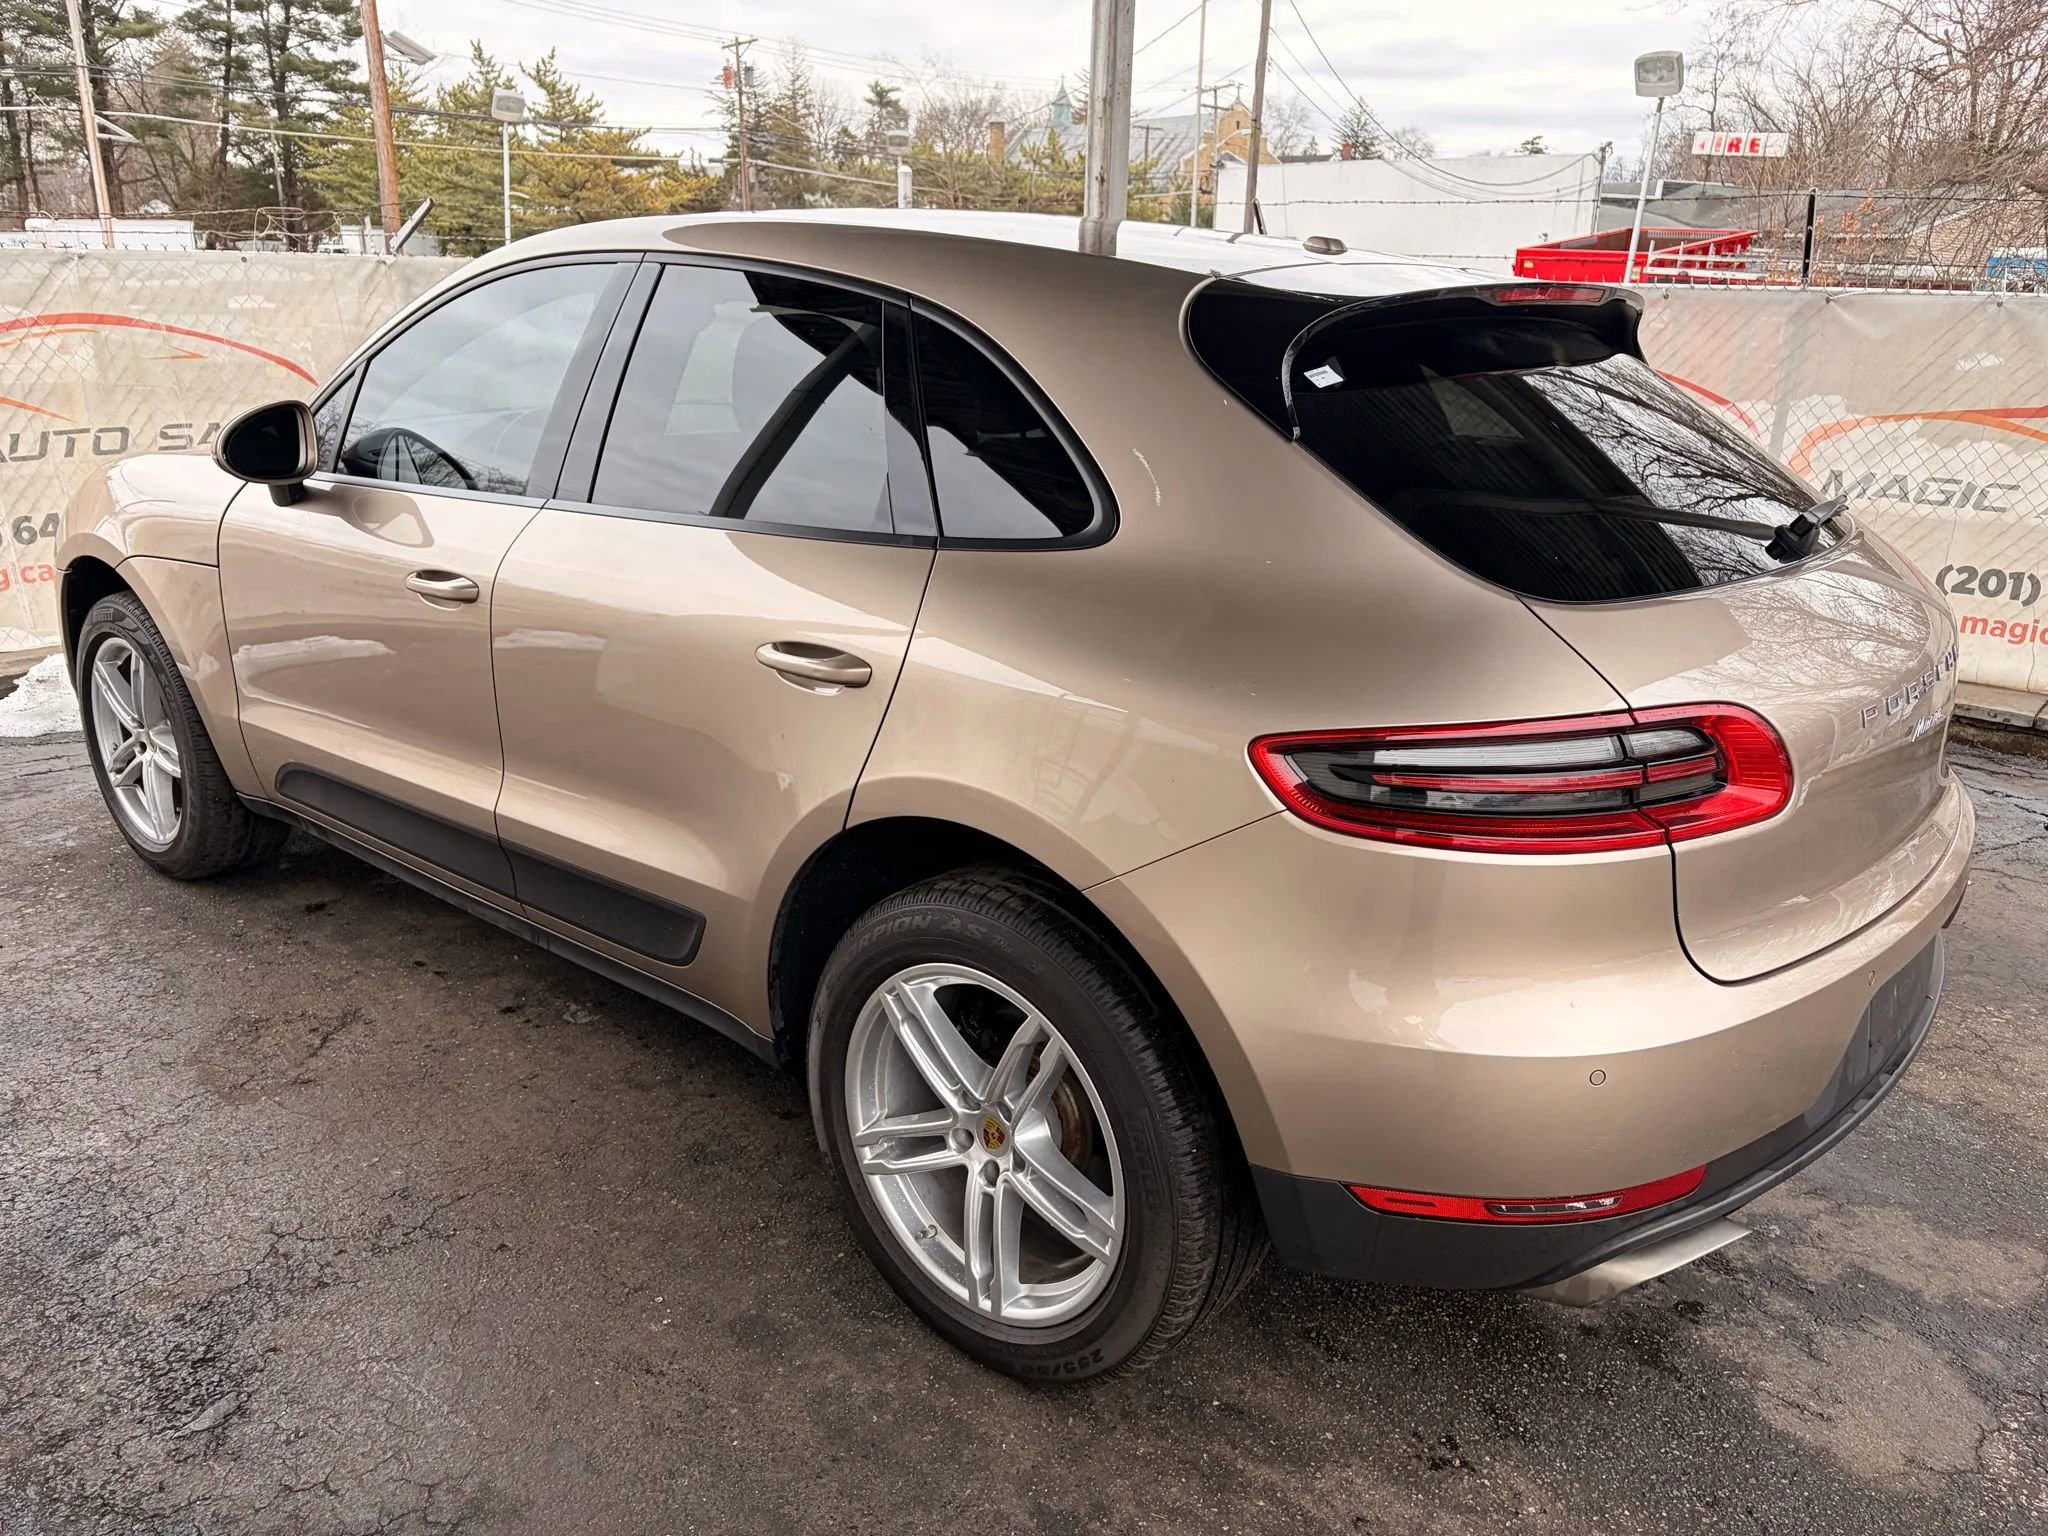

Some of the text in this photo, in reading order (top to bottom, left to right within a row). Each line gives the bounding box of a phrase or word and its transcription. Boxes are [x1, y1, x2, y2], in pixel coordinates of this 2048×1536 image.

[1698, 136, 1761, 154] IRE
[0, 426, 130, 463] UTO
[1820, 469, 2021, 513] MAGIC
[1935, 564, 2042, 607] (201)
[1860, 645, 1959, 729] PORSCH
